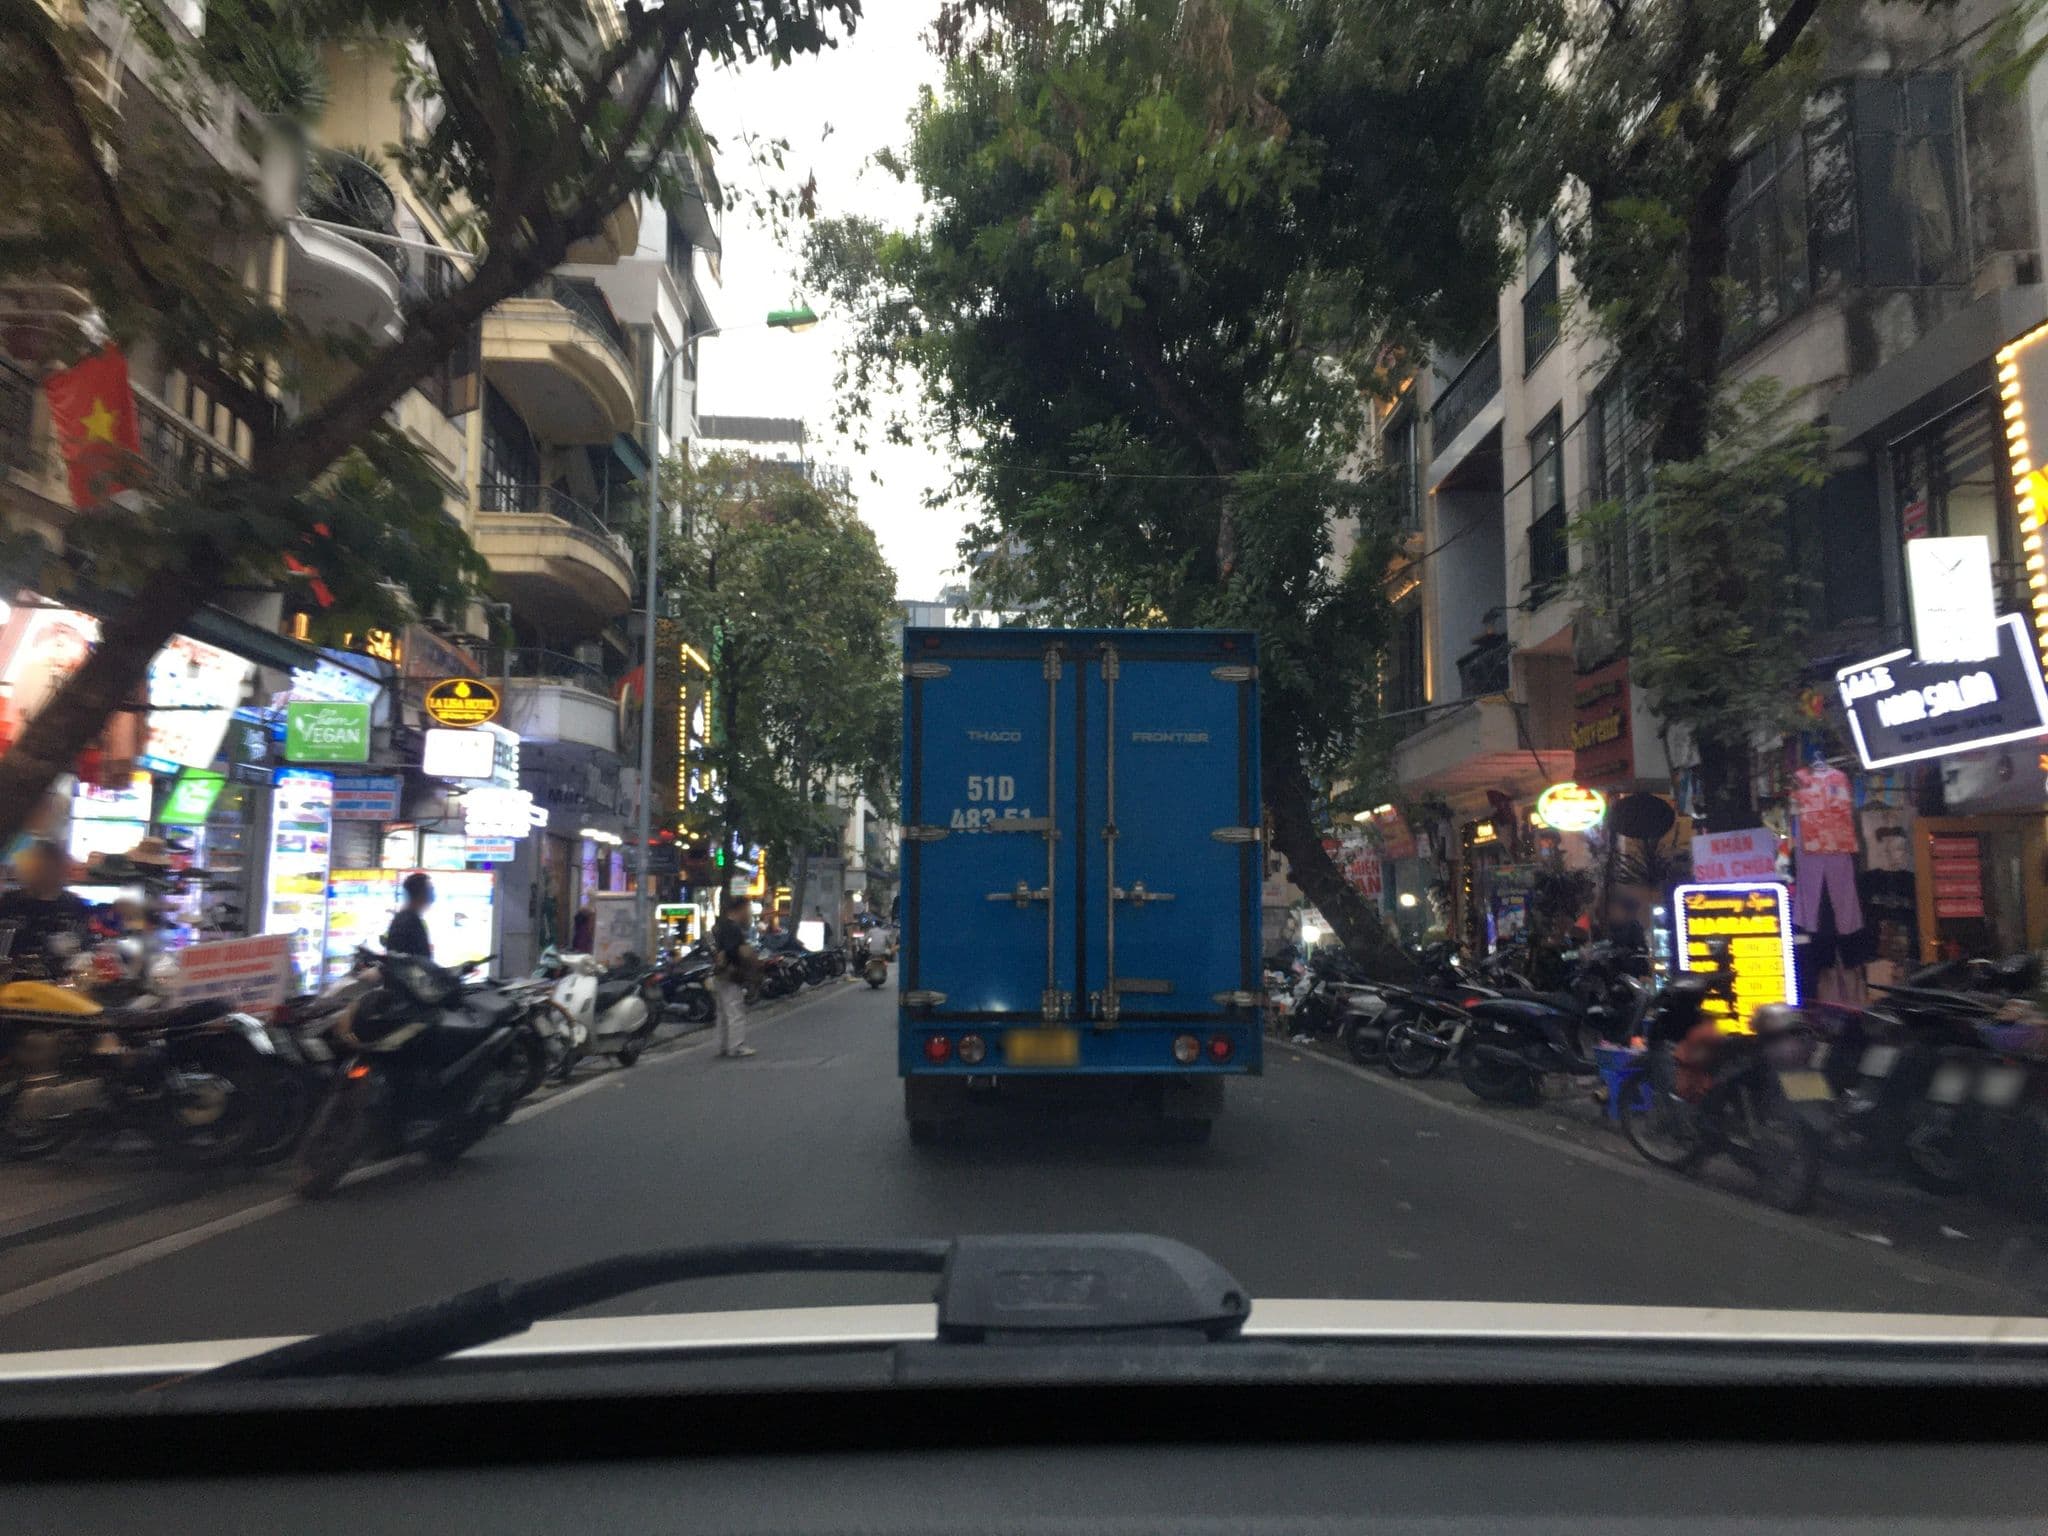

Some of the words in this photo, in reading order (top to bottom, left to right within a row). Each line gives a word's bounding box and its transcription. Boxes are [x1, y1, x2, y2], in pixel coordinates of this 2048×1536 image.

[464, 699, 495, 710] HOTEL
[296, 717, 361, 744] VEGAN
[967, 731, 1022, 742] THACO
[1131, 732, 1209, 743] FRONTIER
[967, 775, 1015, 801] 51D
